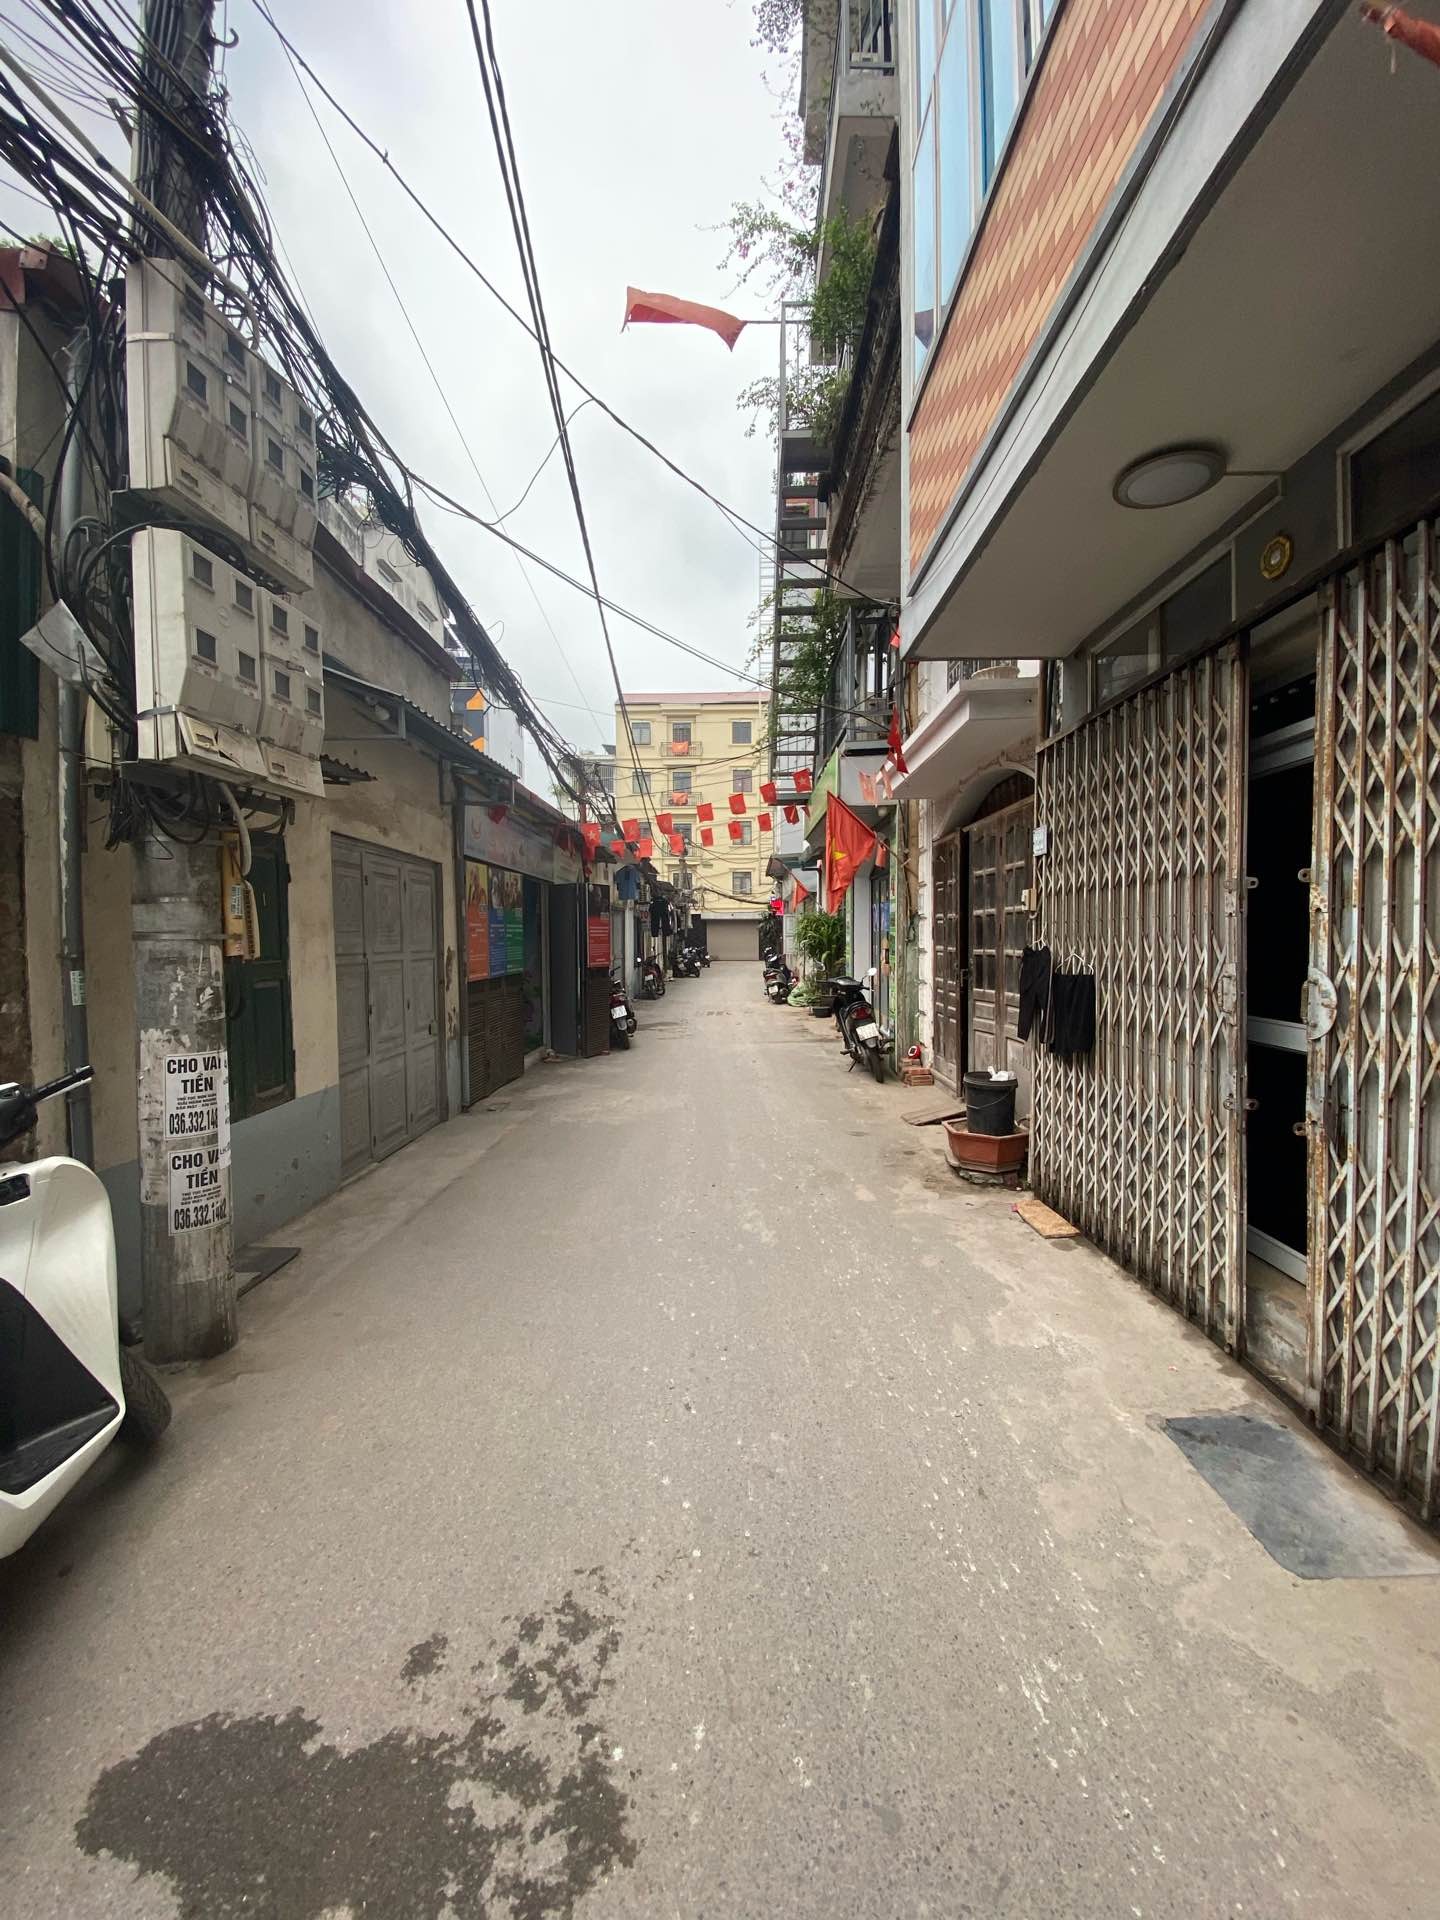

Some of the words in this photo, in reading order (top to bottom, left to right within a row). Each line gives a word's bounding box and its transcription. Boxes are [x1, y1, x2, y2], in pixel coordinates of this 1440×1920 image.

[167, 1058, 198, 1074] CHO
[181, 1073, 213, 1094] TIỀN
[172, 1152, 203, 1170] CHO
[186, 1167, 218, 1189] TIỀN
